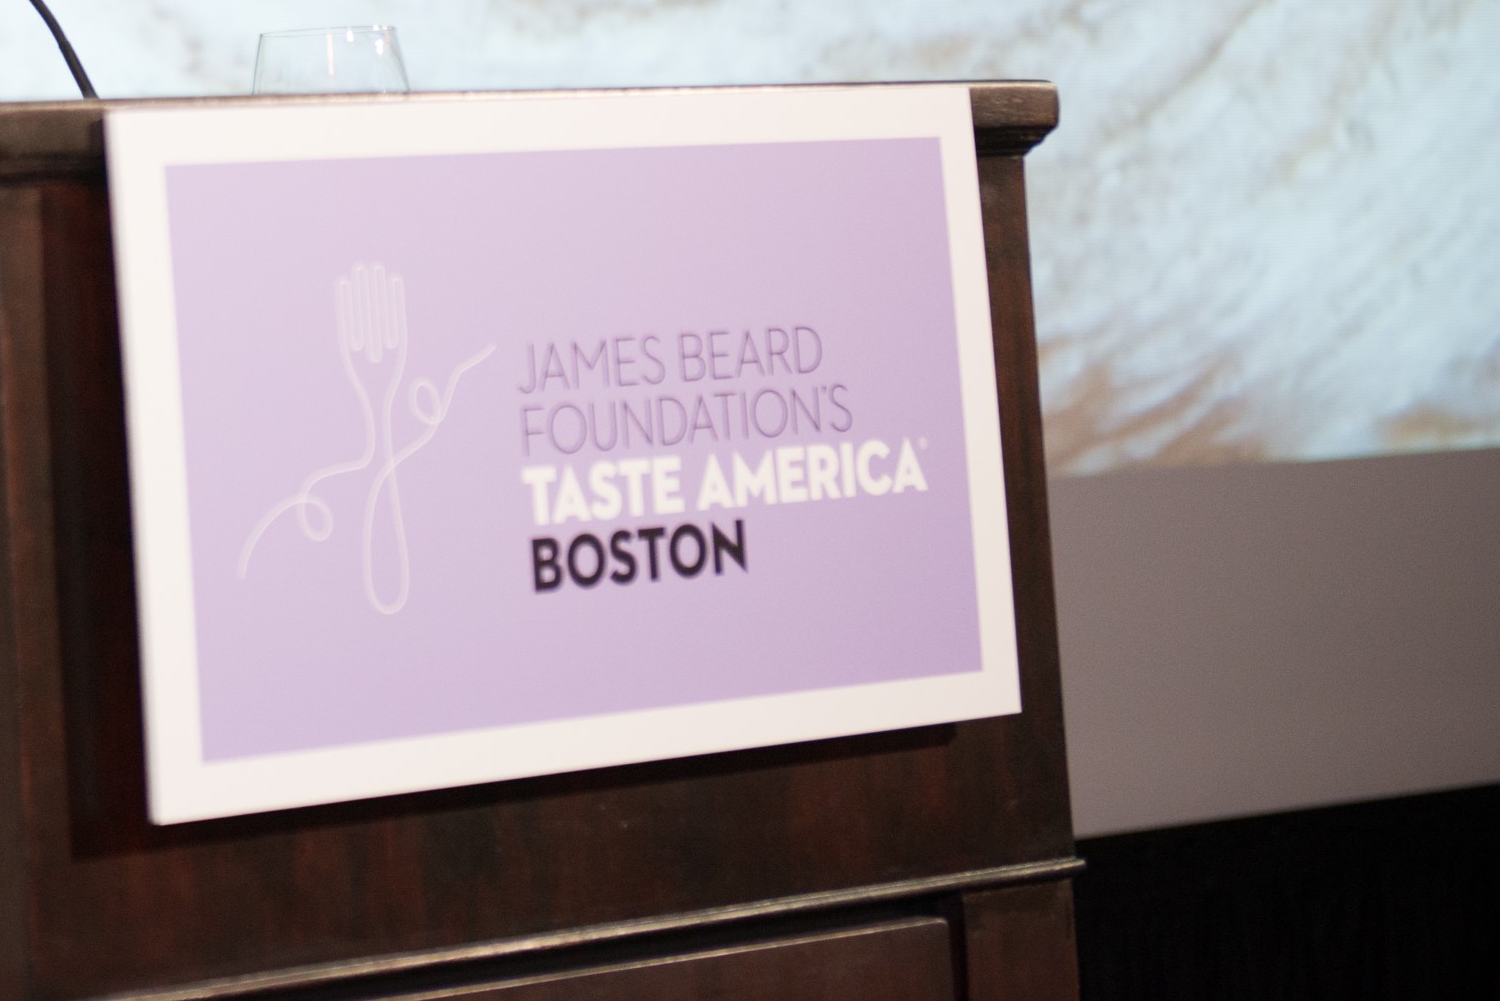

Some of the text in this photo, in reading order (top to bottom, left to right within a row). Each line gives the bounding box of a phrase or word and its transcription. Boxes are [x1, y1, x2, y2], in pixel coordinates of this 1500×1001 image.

[518, 326, 823, 395] JAMES BEARD
[521, 384, 854, 456] FOUNDATION'S
[521, 437, 929, 525] TASTE AMERICA
[531, 519, 748, 594] BOSTON
